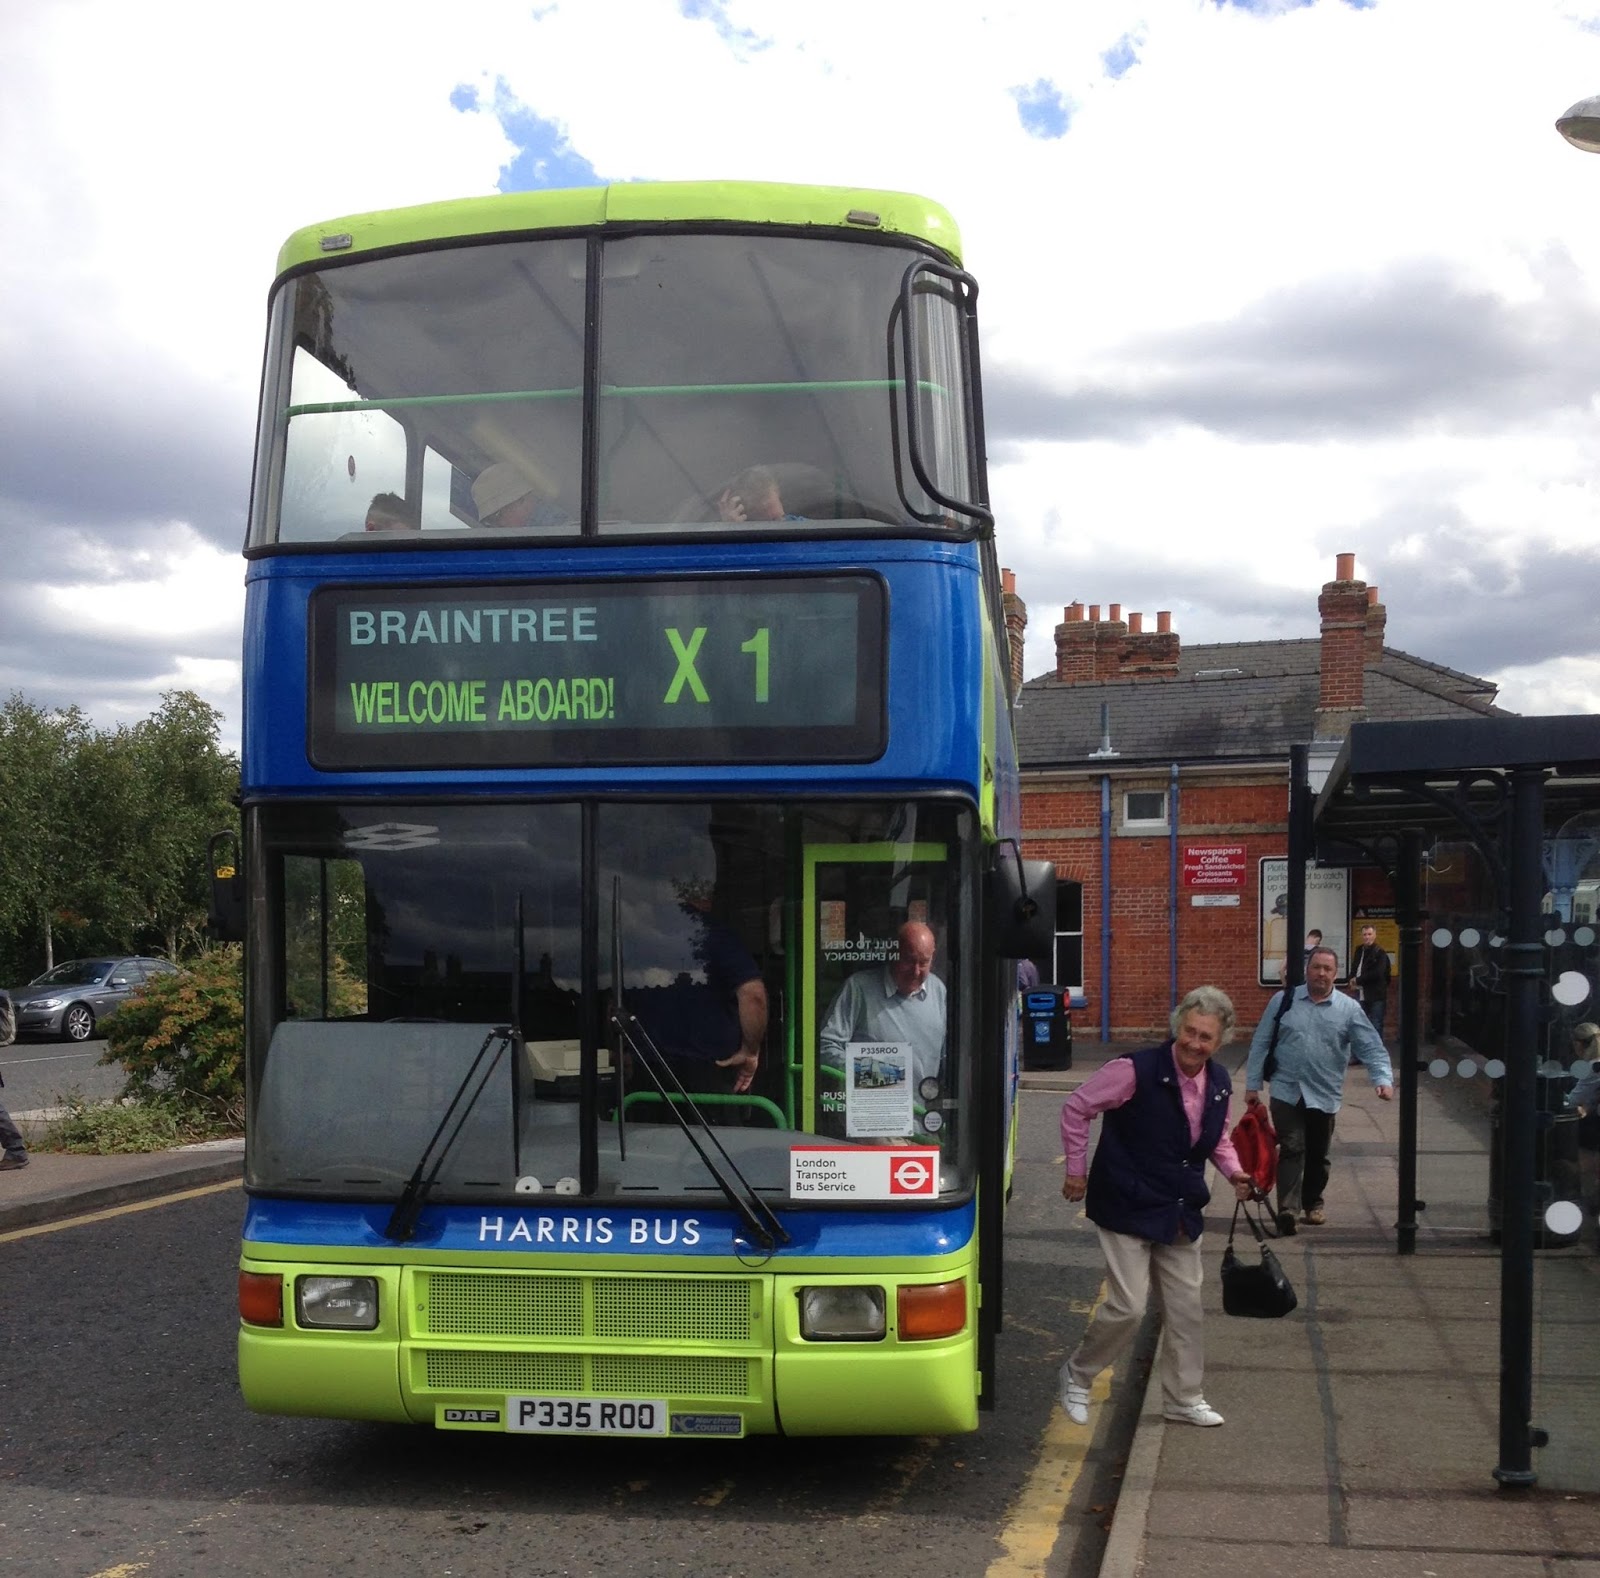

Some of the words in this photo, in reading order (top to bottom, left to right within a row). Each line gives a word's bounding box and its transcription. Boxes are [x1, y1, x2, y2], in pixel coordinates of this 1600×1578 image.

[350, 607, 598, 645] BRAINTREE
[663, 627, 711, 704] X
[741, 627, 769, 703] 1
[350, 680, 487, 724] WELCOME
[497, 677, 615, 722] ABOARD!
[1188, 848, 1242, 856] Newspapers
[1200, 856, 1229, 864] Coffee
[822, 1103, 835, 1112] IN
[796, 1158, 836, 1168] London
[796, 1170, 847, 1181] Transport
[795, 1182, 815, 1192] Bus
[817, 1182, 856, 1192] Service
[479, 1216, 614, 1244] HARRIS
[629, 1218, 700, 1245] BUS
[446, 1410, 498, 1422] DAF
[519, 1400, 592, 1428] P335
[694, 1424, 740, 1432] COUNTIES
